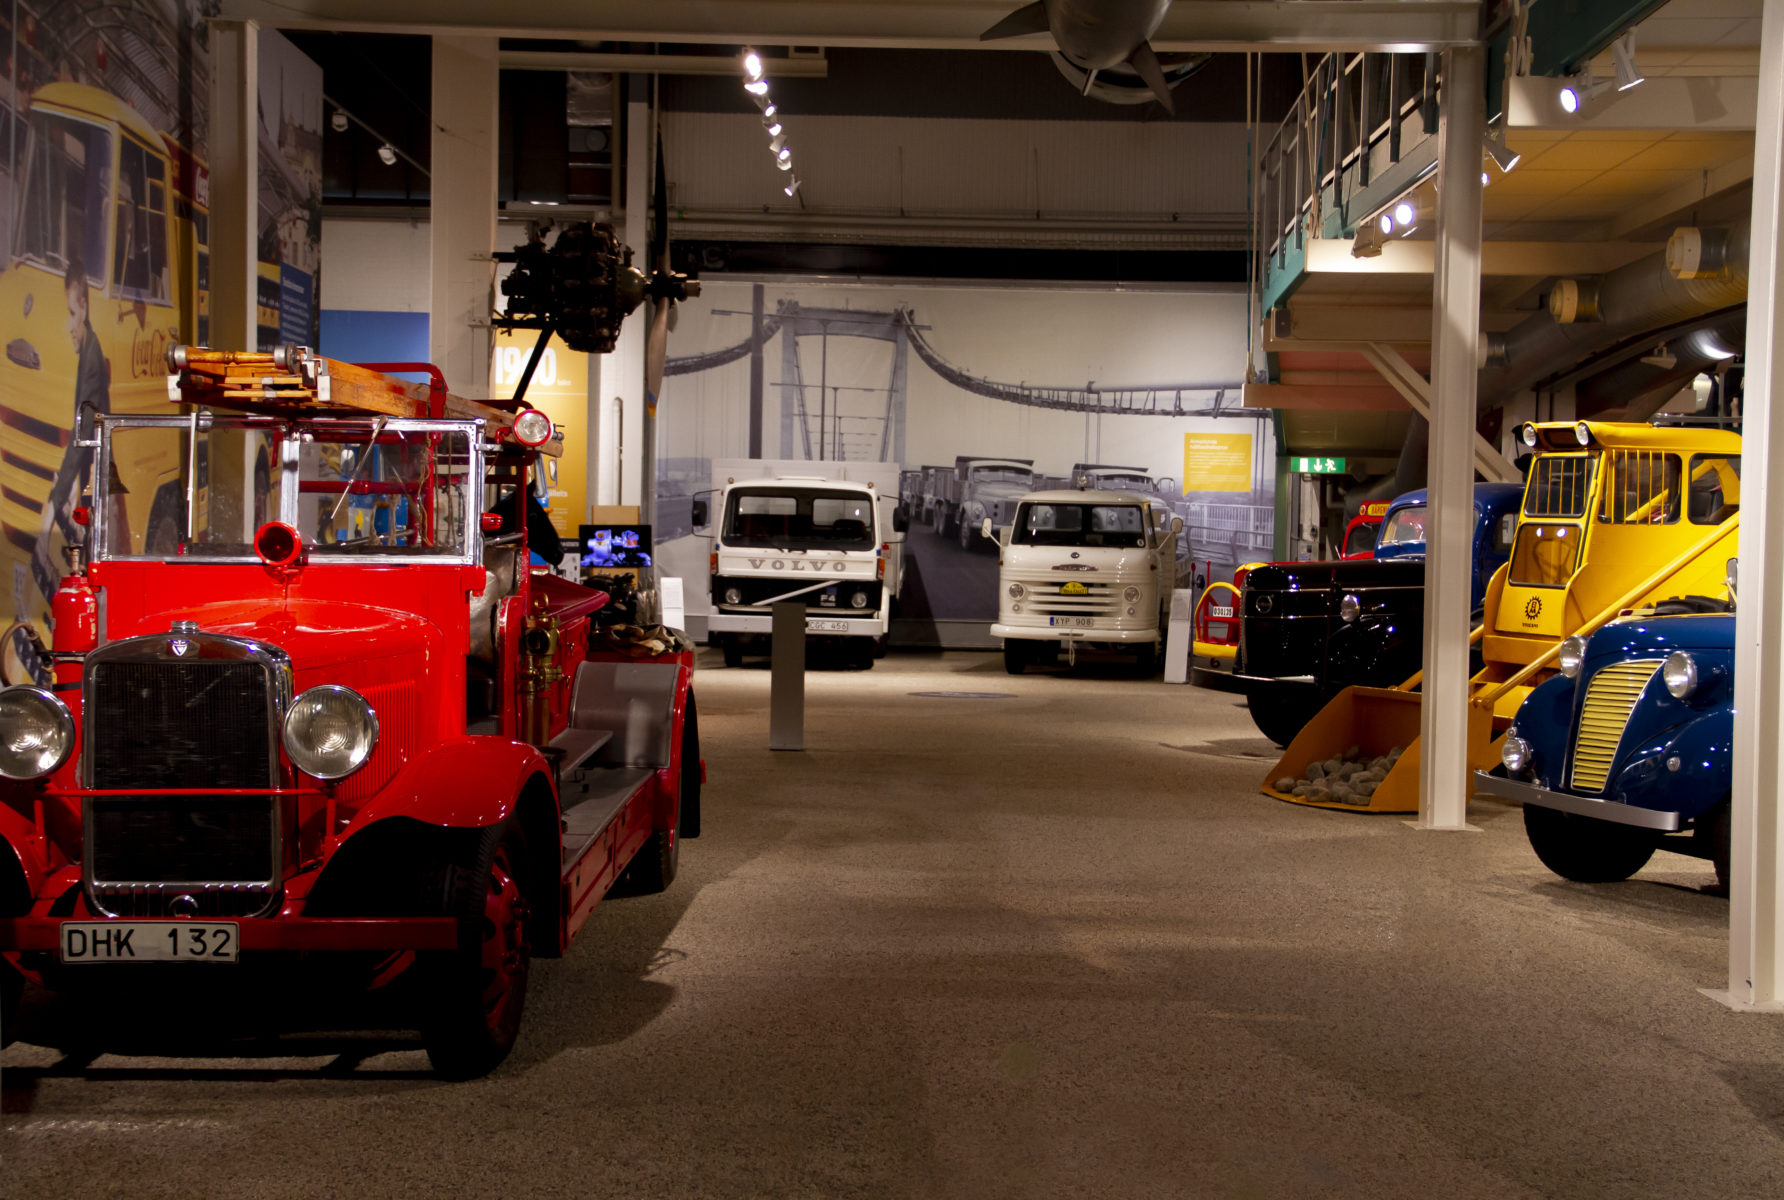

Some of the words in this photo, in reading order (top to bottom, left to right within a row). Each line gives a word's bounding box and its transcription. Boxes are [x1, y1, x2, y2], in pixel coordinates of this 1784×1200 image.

[748, 559, 847, 572] VOLVO
[830, 622, 847, 630] 456
[1055, 617, 1070, 625] XYP
[67, 928, 135, 957] DHK
[167, 928, 231, 957] 132
